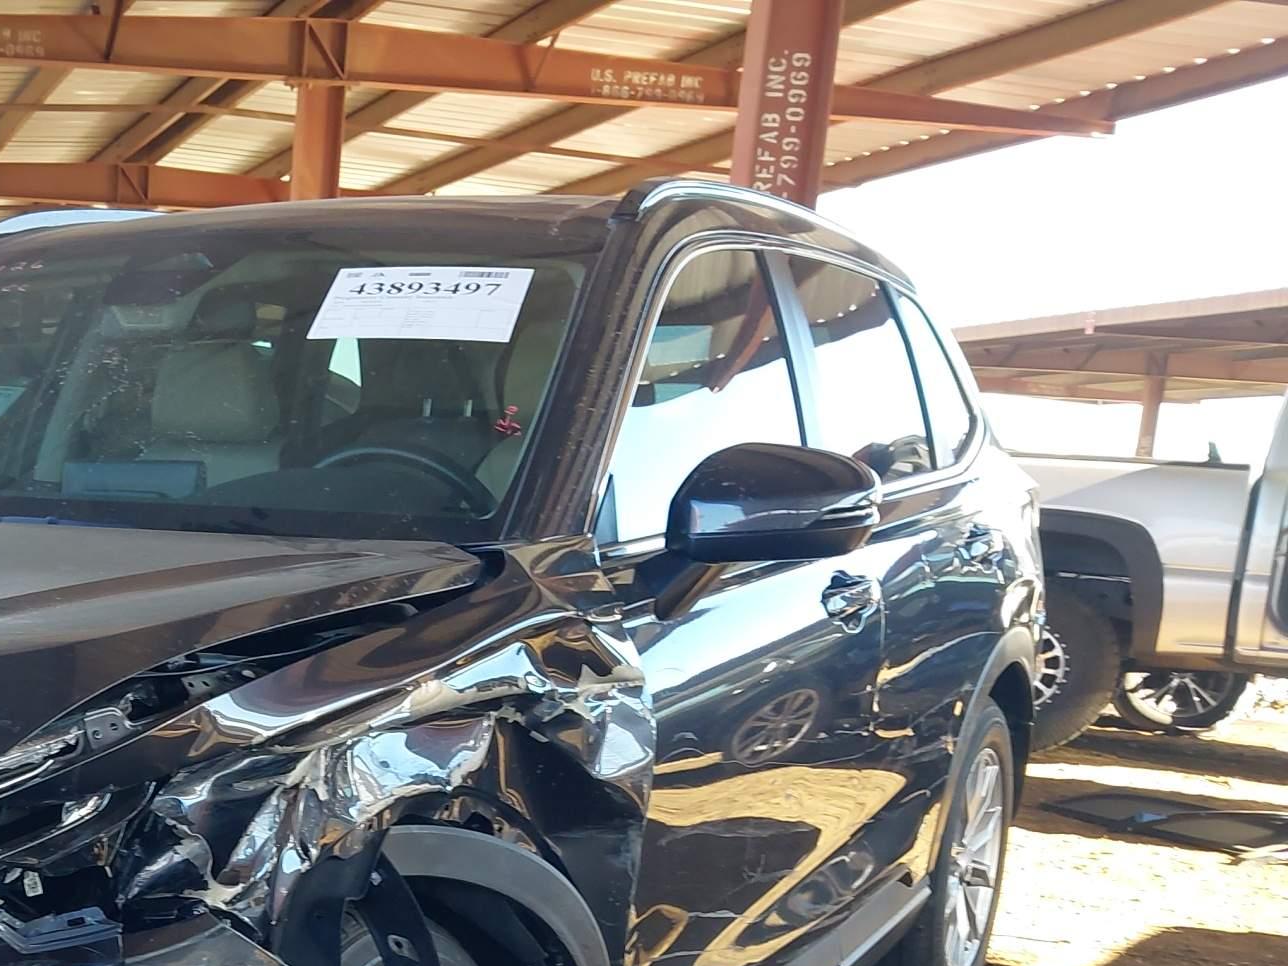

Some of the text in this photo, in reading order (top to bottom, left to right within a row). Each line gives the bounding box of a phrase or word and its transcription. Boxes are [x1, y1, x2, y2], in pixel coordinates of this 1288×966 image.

[591, 68, 617, 83] U.S.
[623, 70, 676, 87] PREFAB
[765, 49, 789, 98] INC.
[348, 281, 503, 297] 43893497
